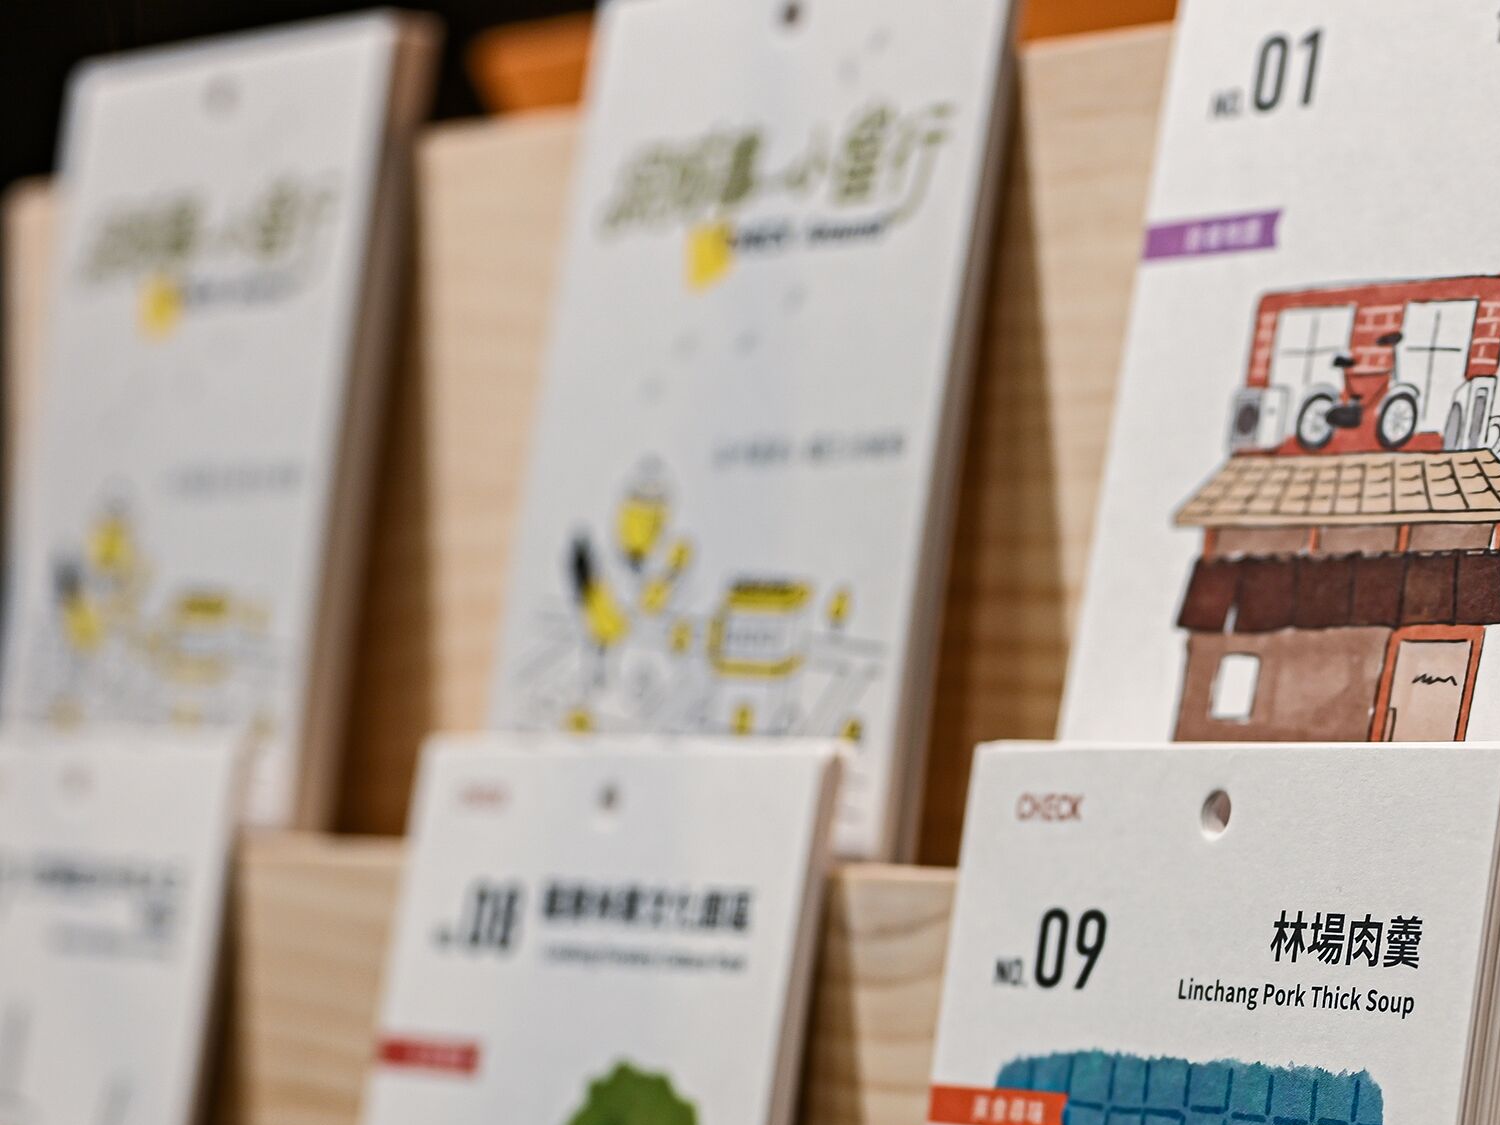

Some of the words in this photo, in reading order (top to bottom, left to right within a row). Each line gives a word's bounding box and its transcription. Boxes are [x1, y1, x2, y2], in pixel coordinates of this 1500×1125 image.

[1253, 28, 1322, 112] 01
[996, 958, 1028, 987] NO.
[1035, 907, 1108, 990] 09
[1270, 910, 1423, 969] 林場肉羹
[1178, 978, 1259, 1010] Linchang
[1263, 984, 1306, 1008] Pork
[1311, 986, 1361, 1011] Thick
[1366, 989, 1415, 1019] Soup
